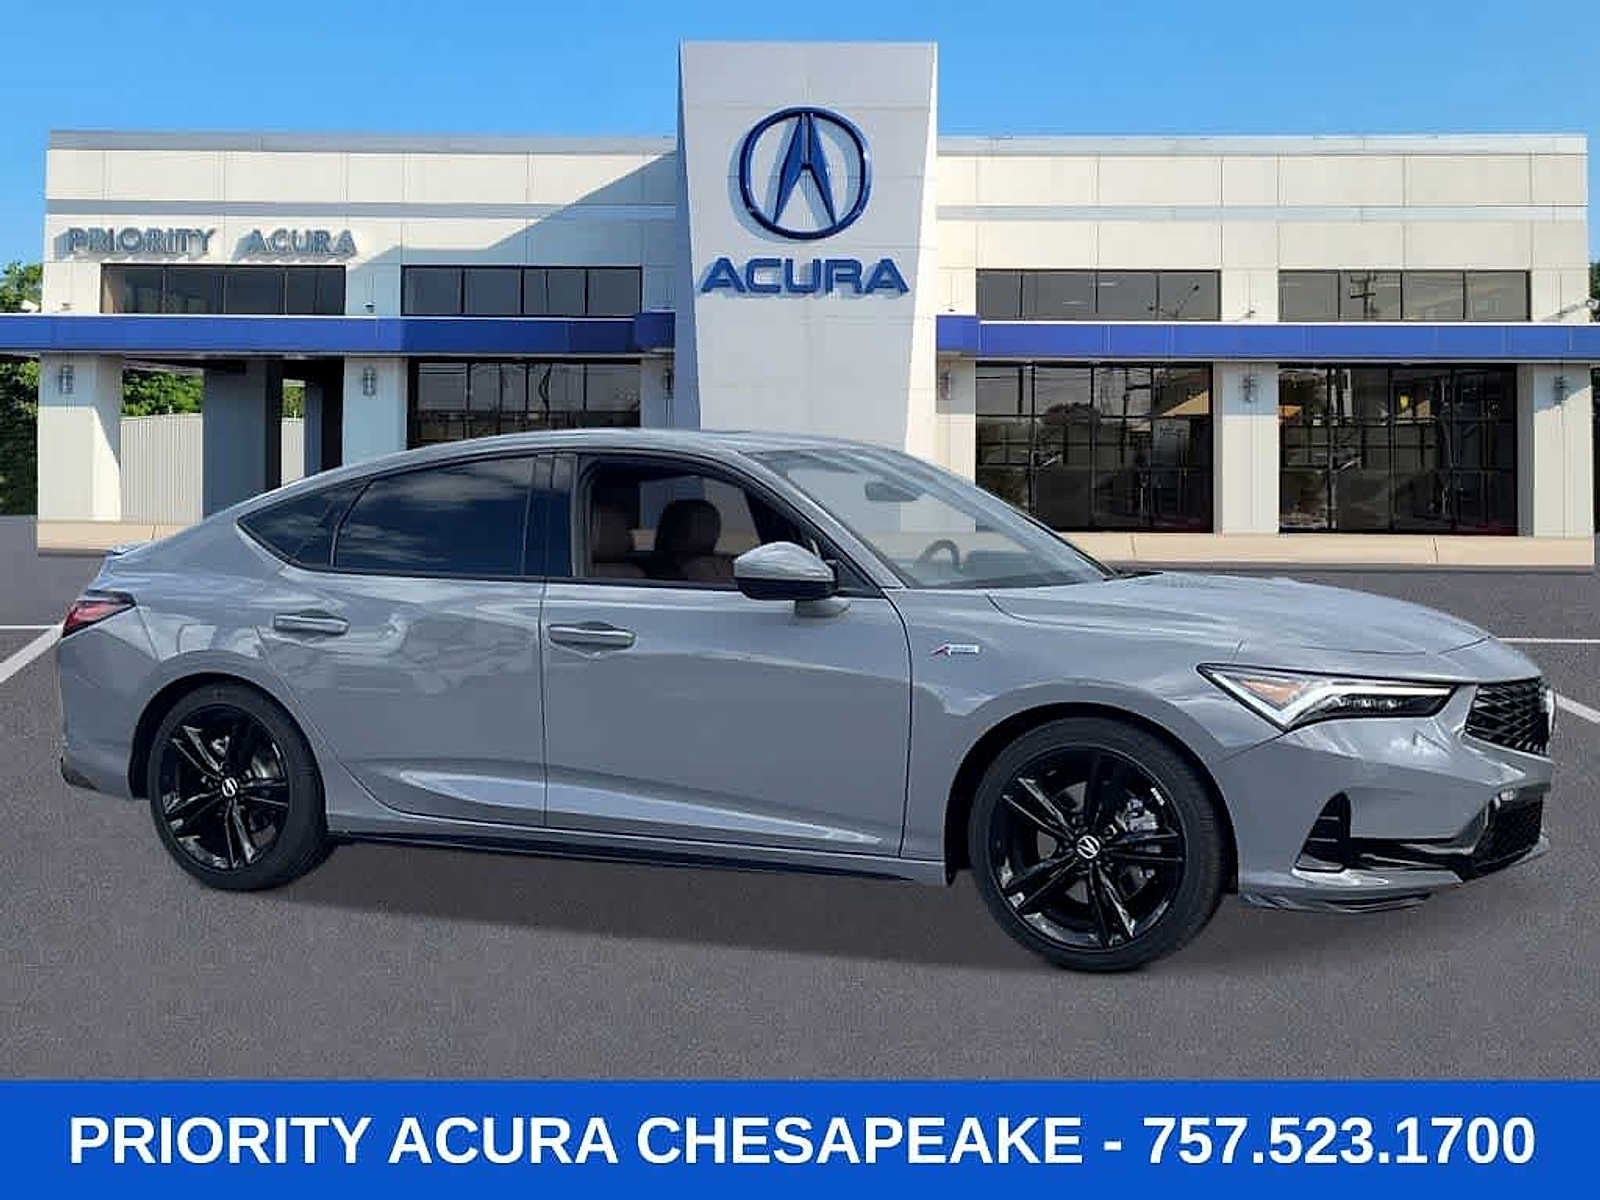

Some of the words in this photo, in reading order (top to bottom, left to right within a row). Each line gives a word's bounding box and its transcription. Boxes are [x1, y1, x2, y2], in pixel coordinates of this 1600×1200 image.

[67, 227, 215, 253] PRIORITY
[247, 228, 357, 254] ACURA
[700, 257, 909, 294] ACURA
